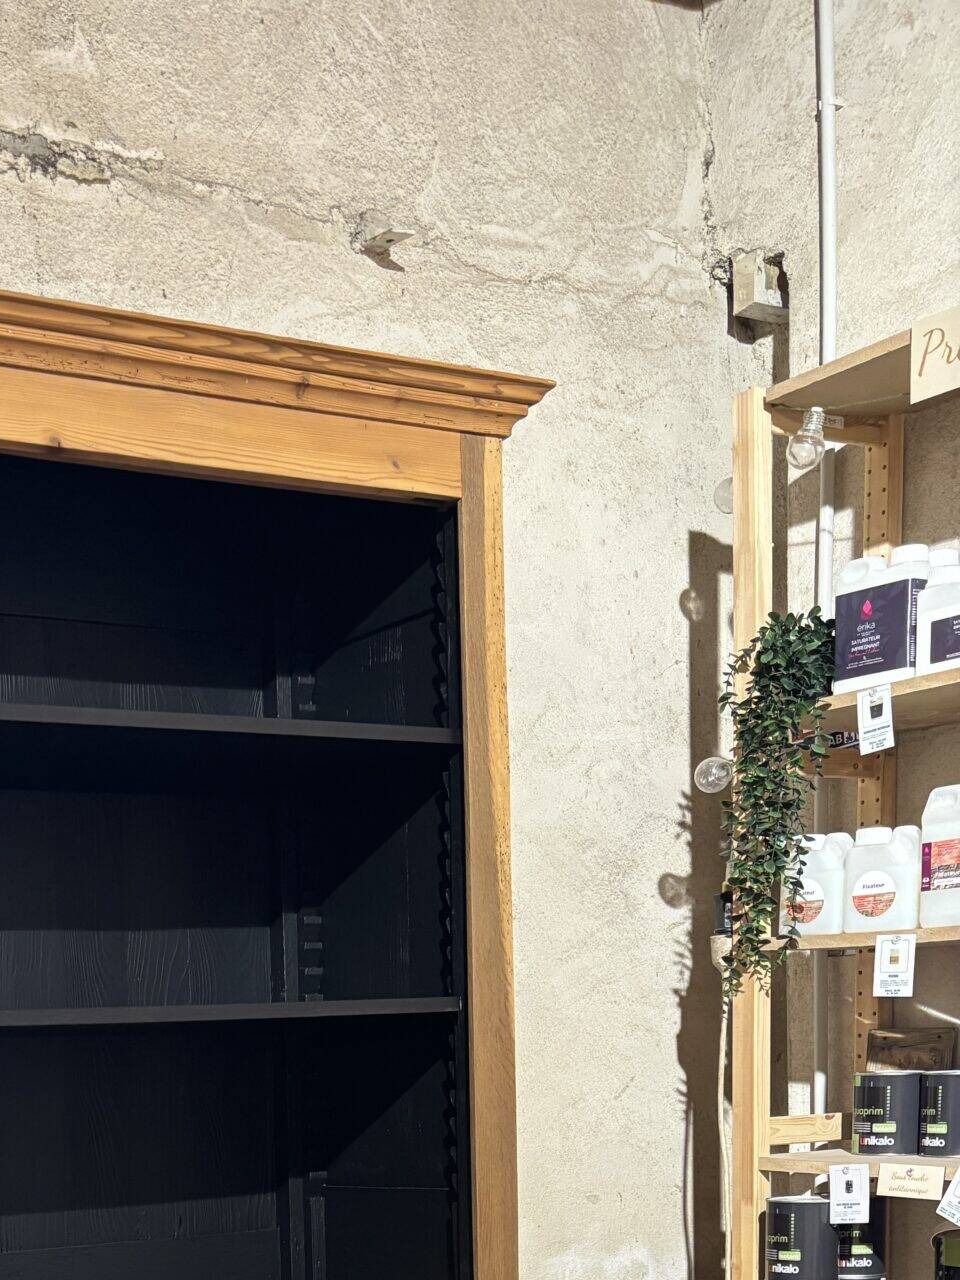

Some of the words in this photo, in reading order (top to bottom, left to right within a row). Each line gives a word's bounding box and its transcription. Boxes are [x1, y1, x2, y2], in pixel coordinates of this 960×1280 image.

[918, 327, 960, 377] Pr
[859, 1136, 895, 1146] unikalo
[922, 1136, 946, 1147] nikalo
